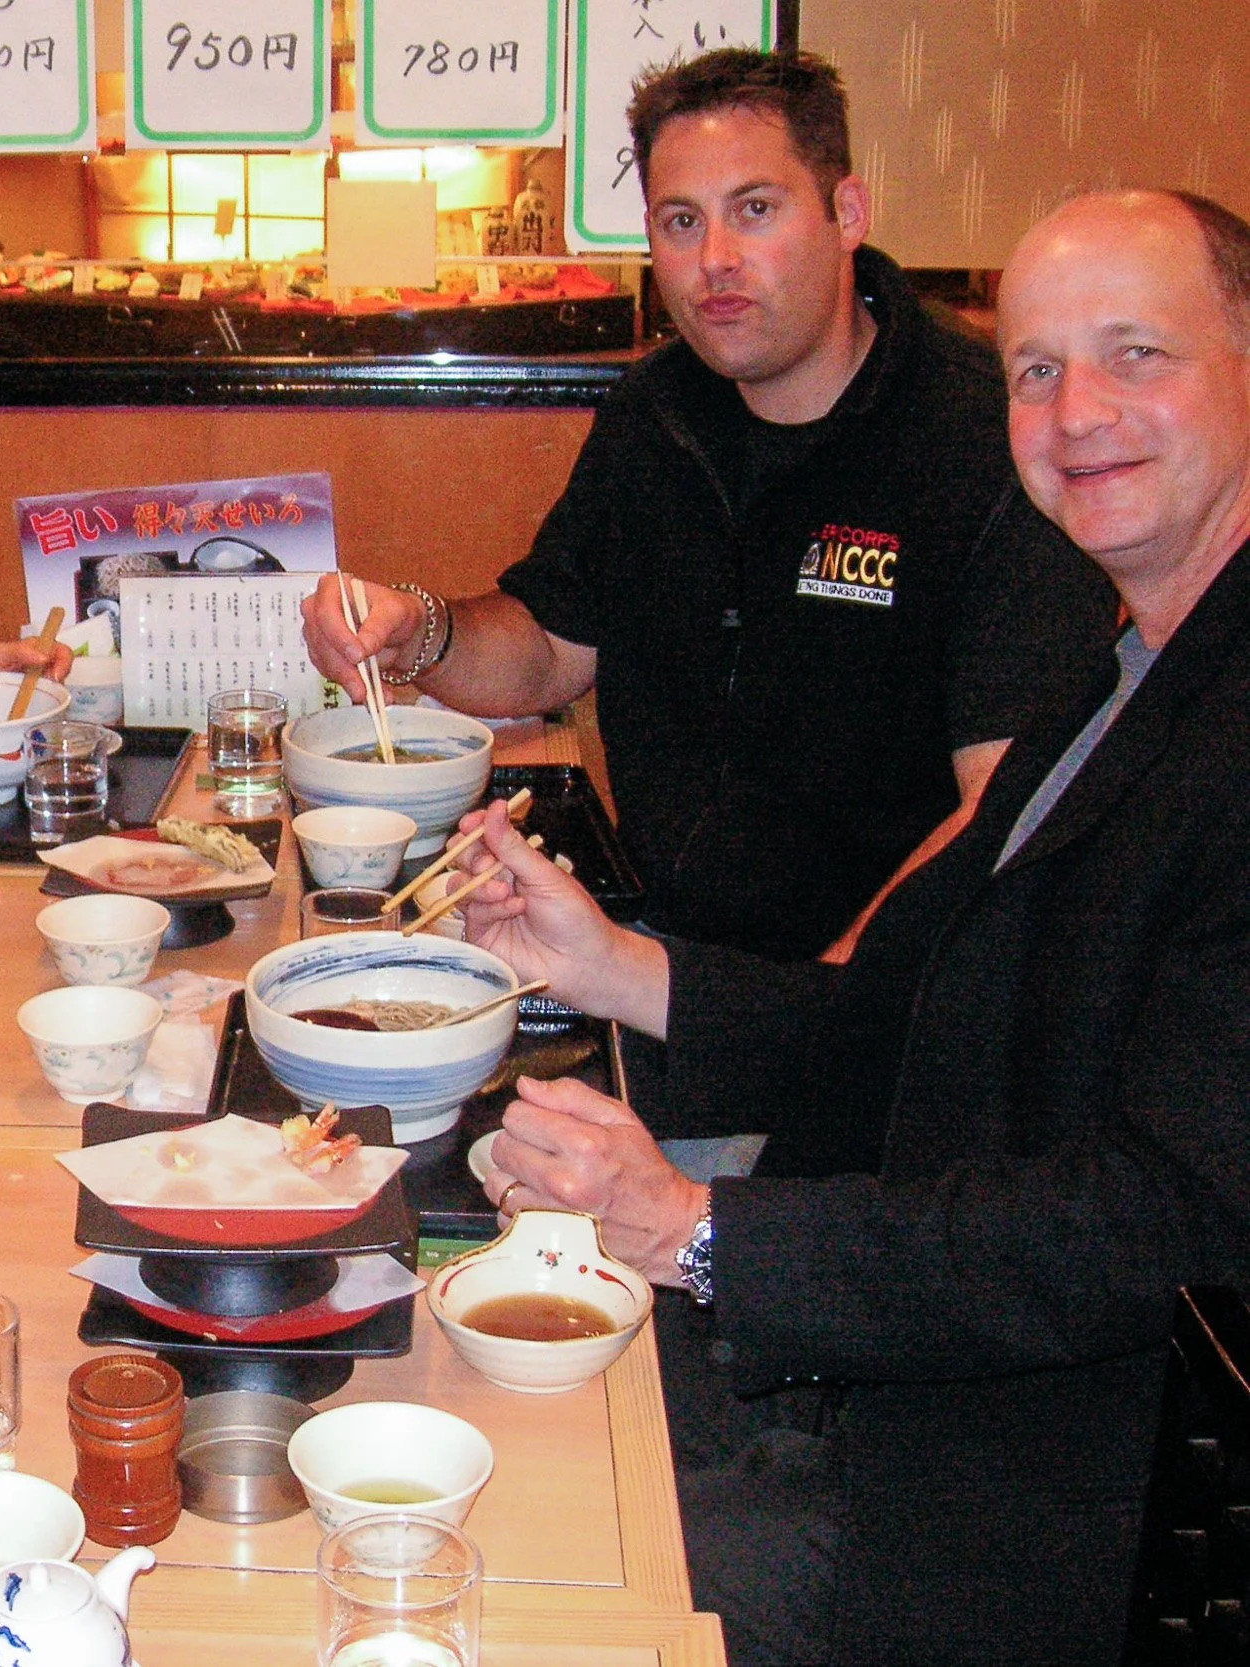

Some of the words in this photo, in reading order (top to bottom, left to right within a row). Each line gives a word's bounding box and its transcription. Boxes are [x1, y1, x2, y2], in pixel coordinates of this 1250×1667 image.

[166, 21, 298, 71] 950円
[404, 40, 519, 78] 780円
[30, 505, 119, 556] 旨い
[820, 541, 898, 588] NCCC
[858, 588, 890, 603] DONE
